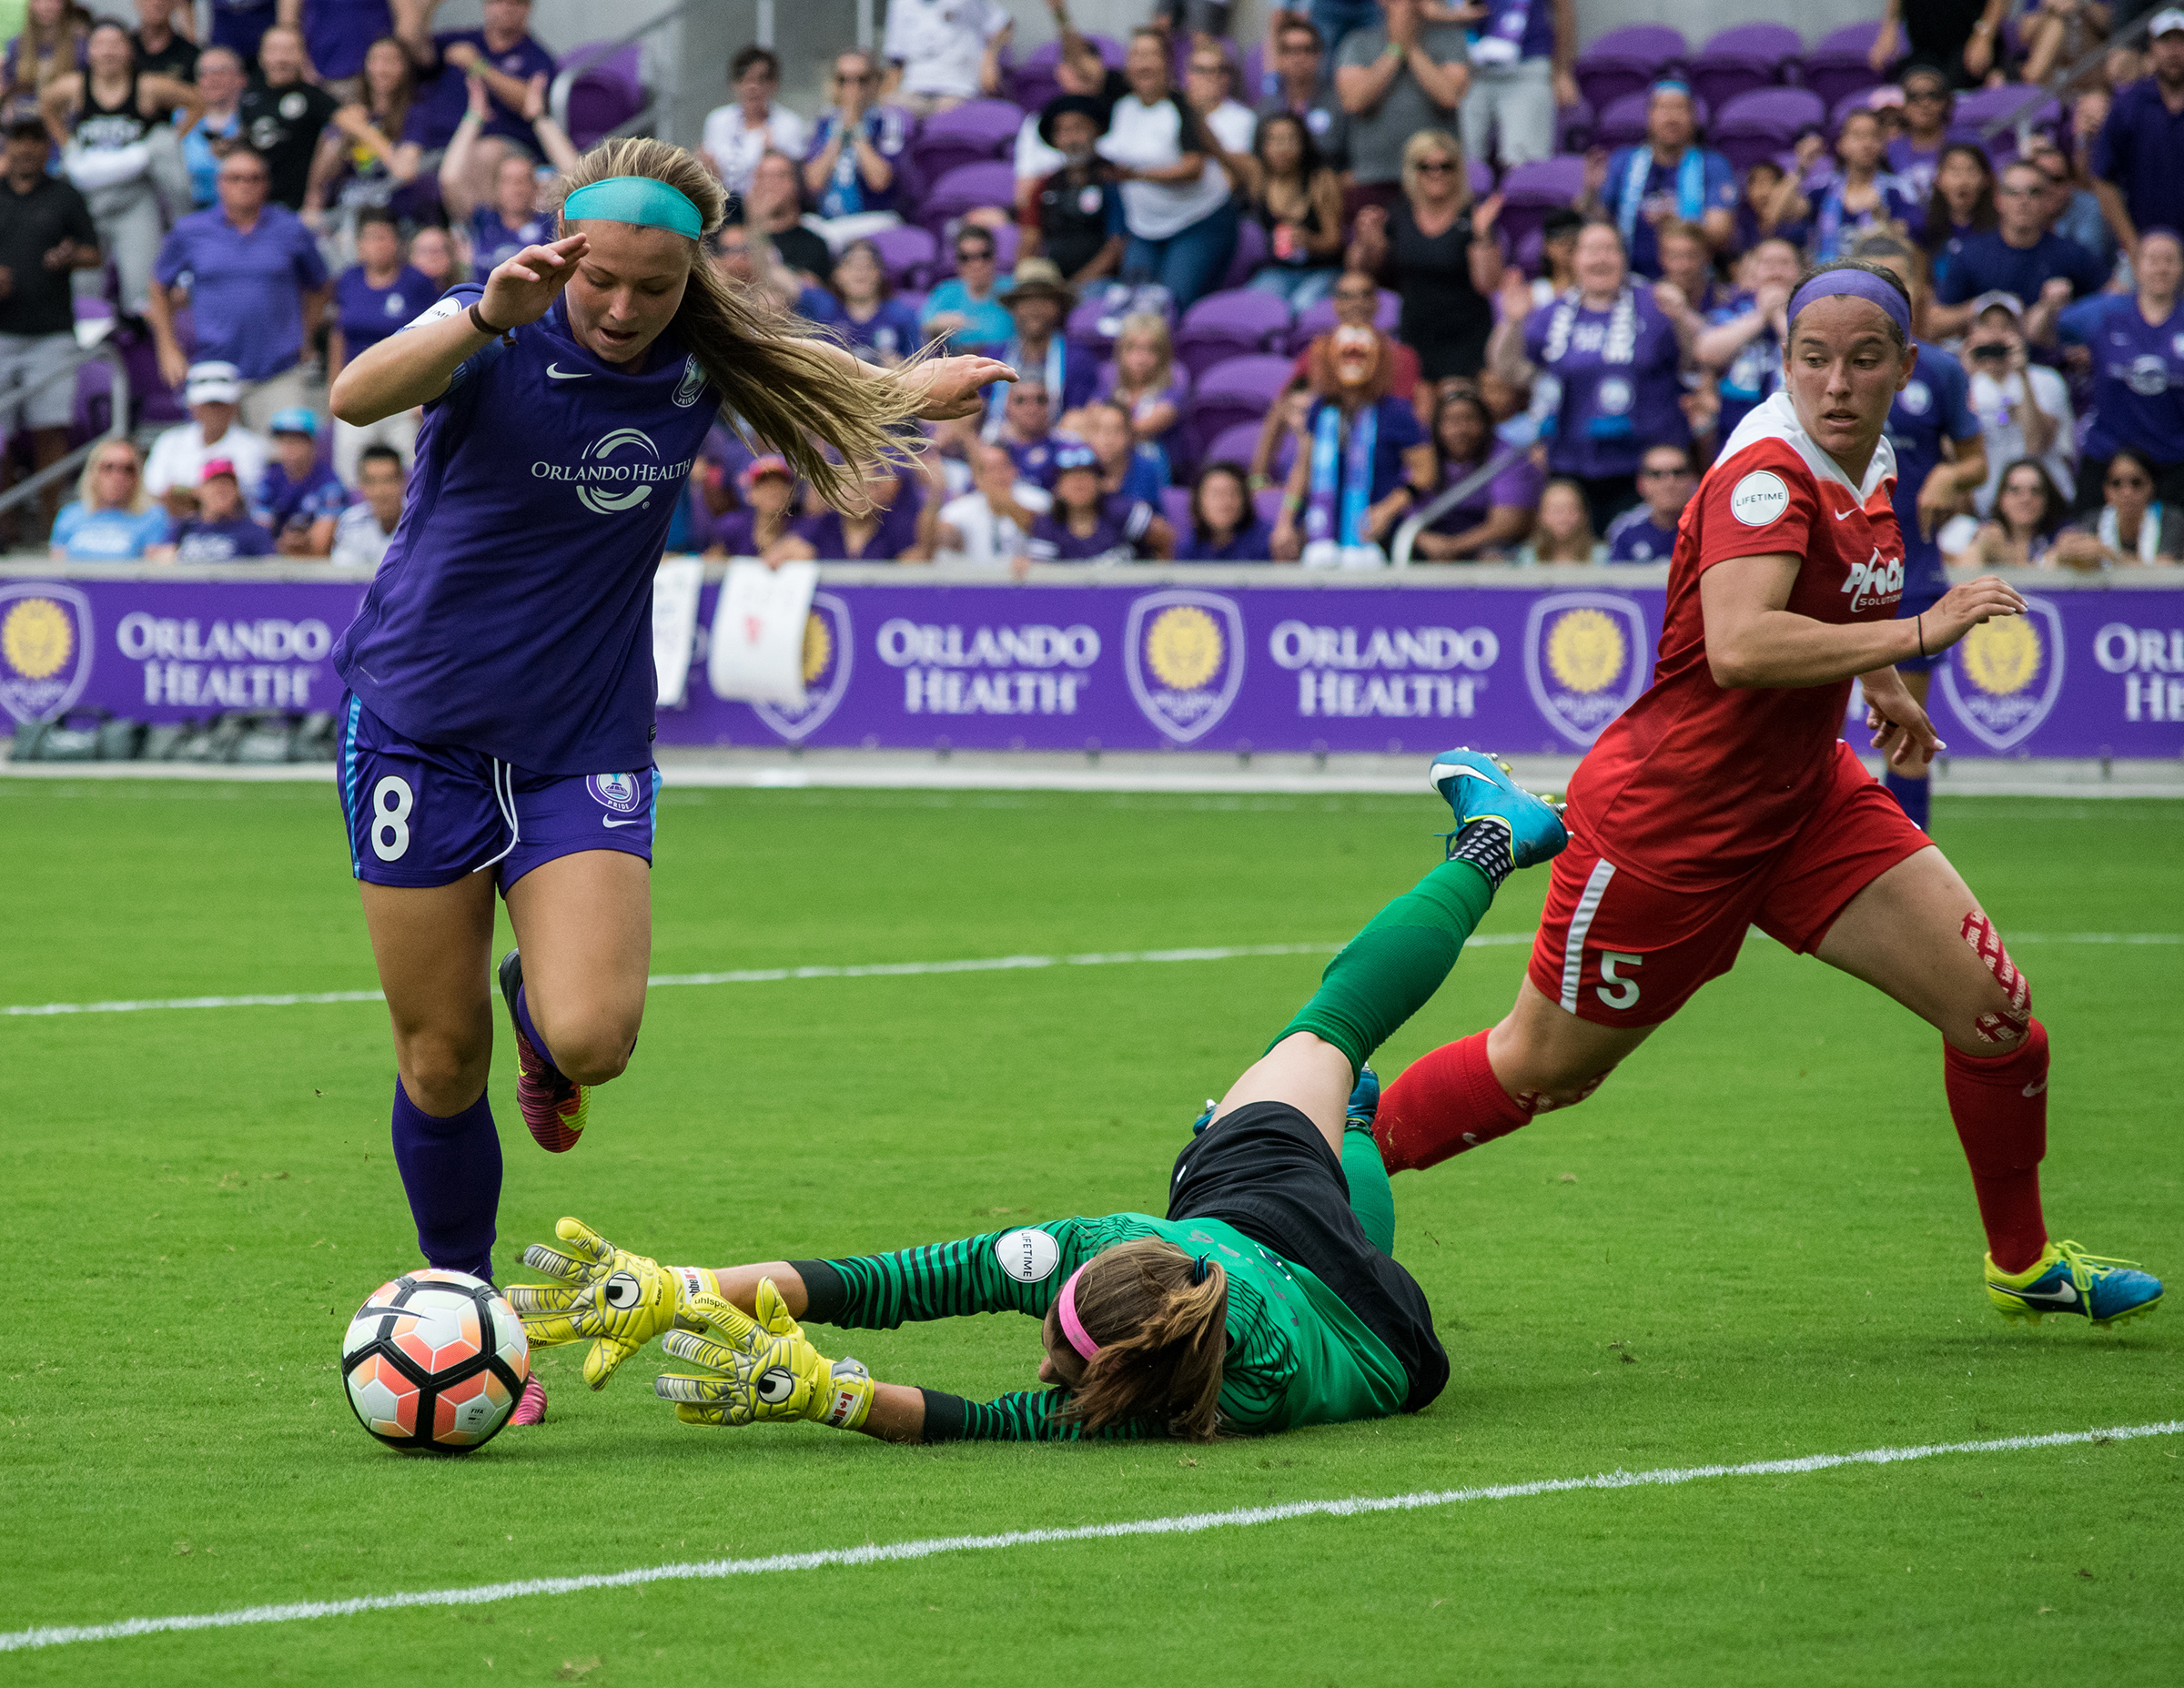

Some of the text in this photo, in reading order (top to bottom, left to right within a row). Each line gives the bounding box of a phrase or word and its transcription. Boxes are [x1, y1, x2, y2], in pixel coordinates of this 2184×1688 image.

[678, 395, 695, 405] PRIDE
[531, 459, 691, 481] ORLANDO HEALTH
[1736, 492, 1784, 507] LIFETIME
[116, 612, 331, 662] ORLANDO
[876, 619, 1101, 668] ORLANDO
[1269, 620, 1500, 670] ORLANDO
[145, 662, 309, 707] HEALTH
[905, 667, 1077, 715] HEALTH
[1299, 671, 1475, 718] HEALTH
[371, 775, 413, 862] 8
[608, 800, 629, 810] PRIDE
[1596, 951, 1643, 1009] 5
[1021, 1232, 1032, 1277] LIFETIME
[694, 1298, 732, 1310] uhlsport
